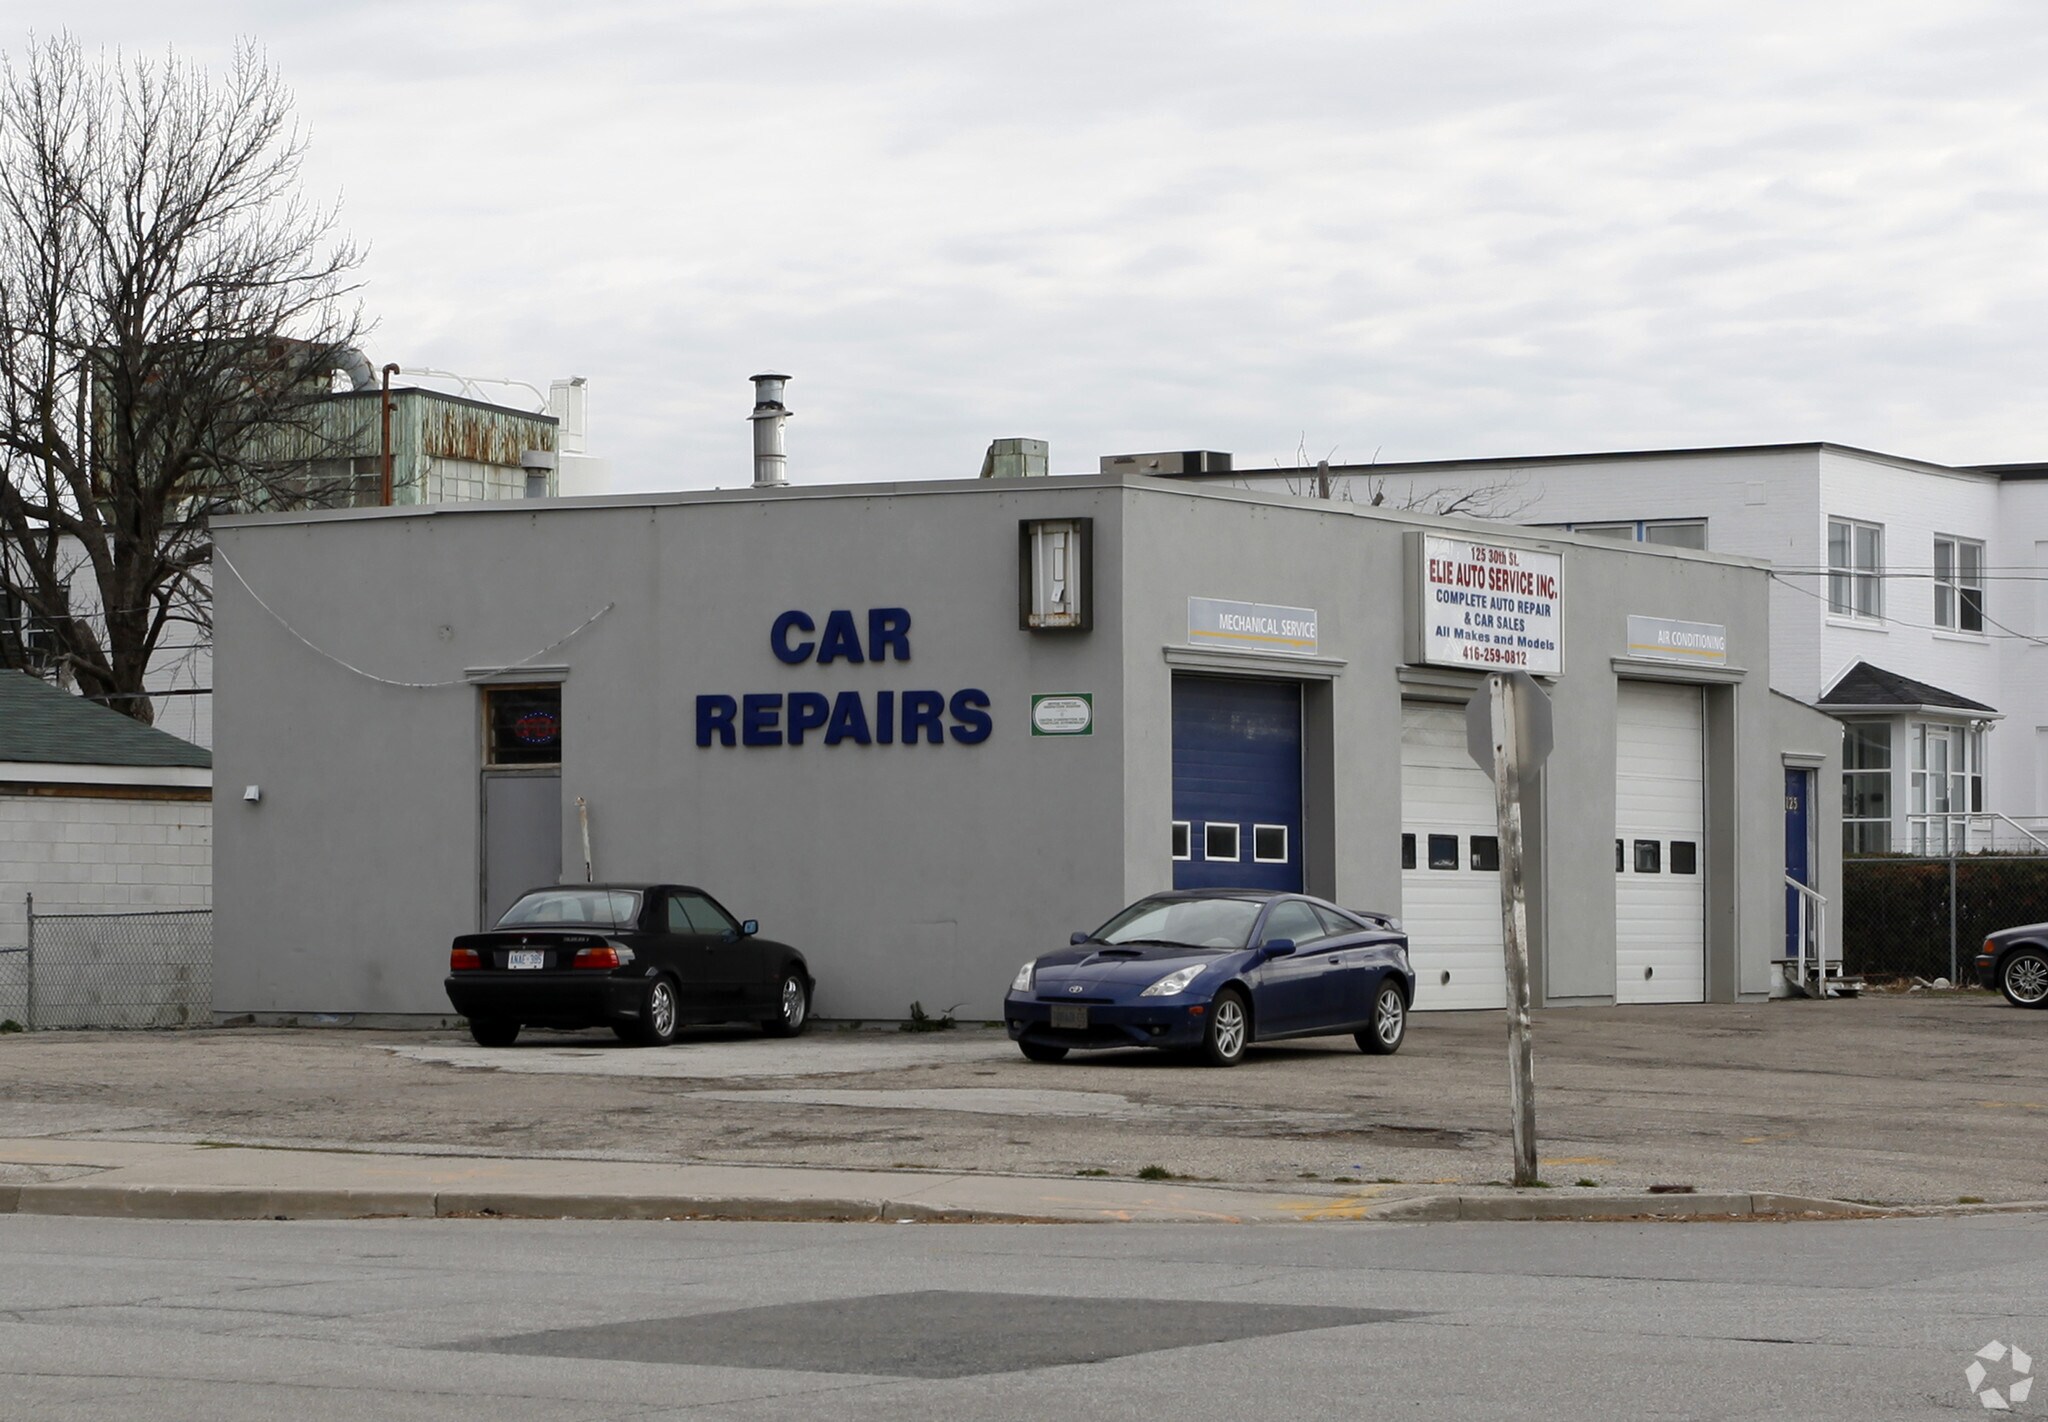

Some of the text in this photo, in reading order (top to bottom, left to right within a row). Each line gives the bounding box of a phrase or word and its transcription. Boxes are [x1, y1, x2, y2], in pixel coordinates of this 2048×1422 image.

[1471, 547, 1520, 567] 125 30th St.
[1429, 559, 1558, 600] ELIE AUTO SERVICE INC.
[1436, 589, 1551, 617] COMPLETE AUTO REPAIR
[1219, 613, 1316, 639] MECHANICAL SERVICE
[1464, 611, 1526, 632] & CAR SALES
[770, 607, 912, 665] CAR
[1435, 625, 1555, 651] All Makes and Models
[1657, 630, 1725, 651] AIR CONDITIONING
[1462, 646, 1527, 666] 416-259-0812
[695, 688, 993, 748] REPAIRS
